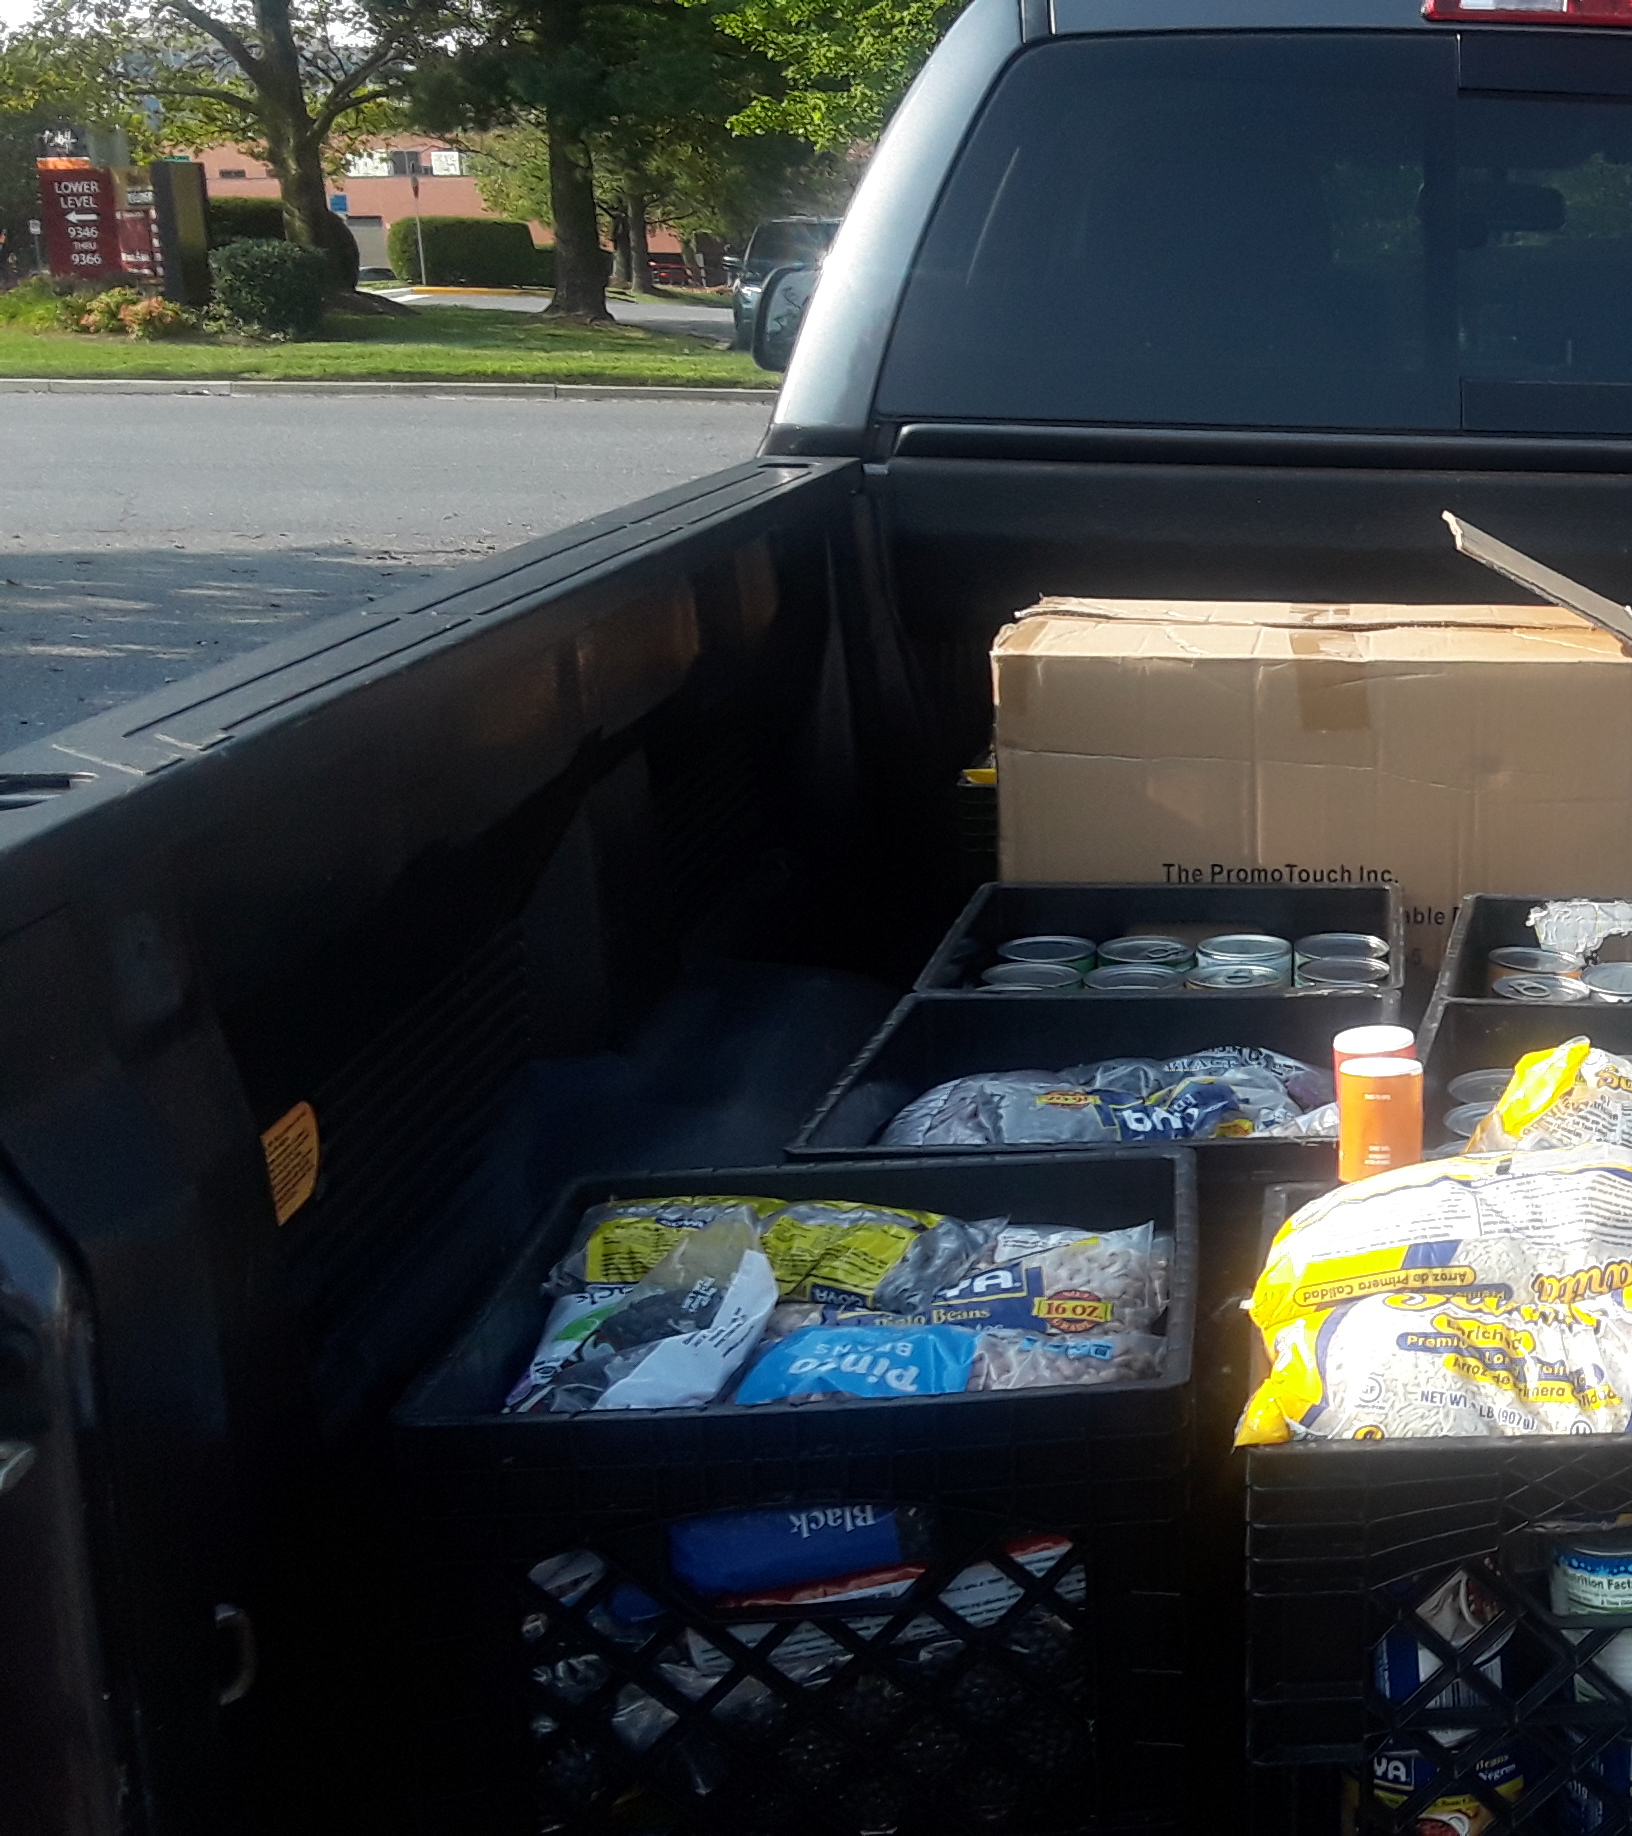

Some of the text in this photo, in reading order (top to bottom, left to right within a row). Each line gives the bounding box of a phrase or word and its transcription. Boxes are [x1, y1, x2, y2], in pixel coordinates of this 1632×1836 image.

[54, 181, 100, 193] LOWER
[60, 196, 98, 208] LEVEL
[67, 226, 98, 238] 9346
[71, 253, 102, 265] 9366
[1162, 864, 1399, 884] The PromoTouch Inc.
[1358, 1276, 1409, 1291] Primera
[1434, 1272, 1467, 1283] Arroz
[1303, 1285, 1354, 1301] Calidad
[931, 1306, 992, 1324] Beans
[1046, 1302, 1067, 1316] 16
[788, 1355, 920, 1393] Pinto
[1452, 1356, 1489, 1378] Arroz
[1420, 1390, 1446, 1405] NET
[1479, 1405, 1495, 1419] LB
[788, 1505, 876, 1538] Black
